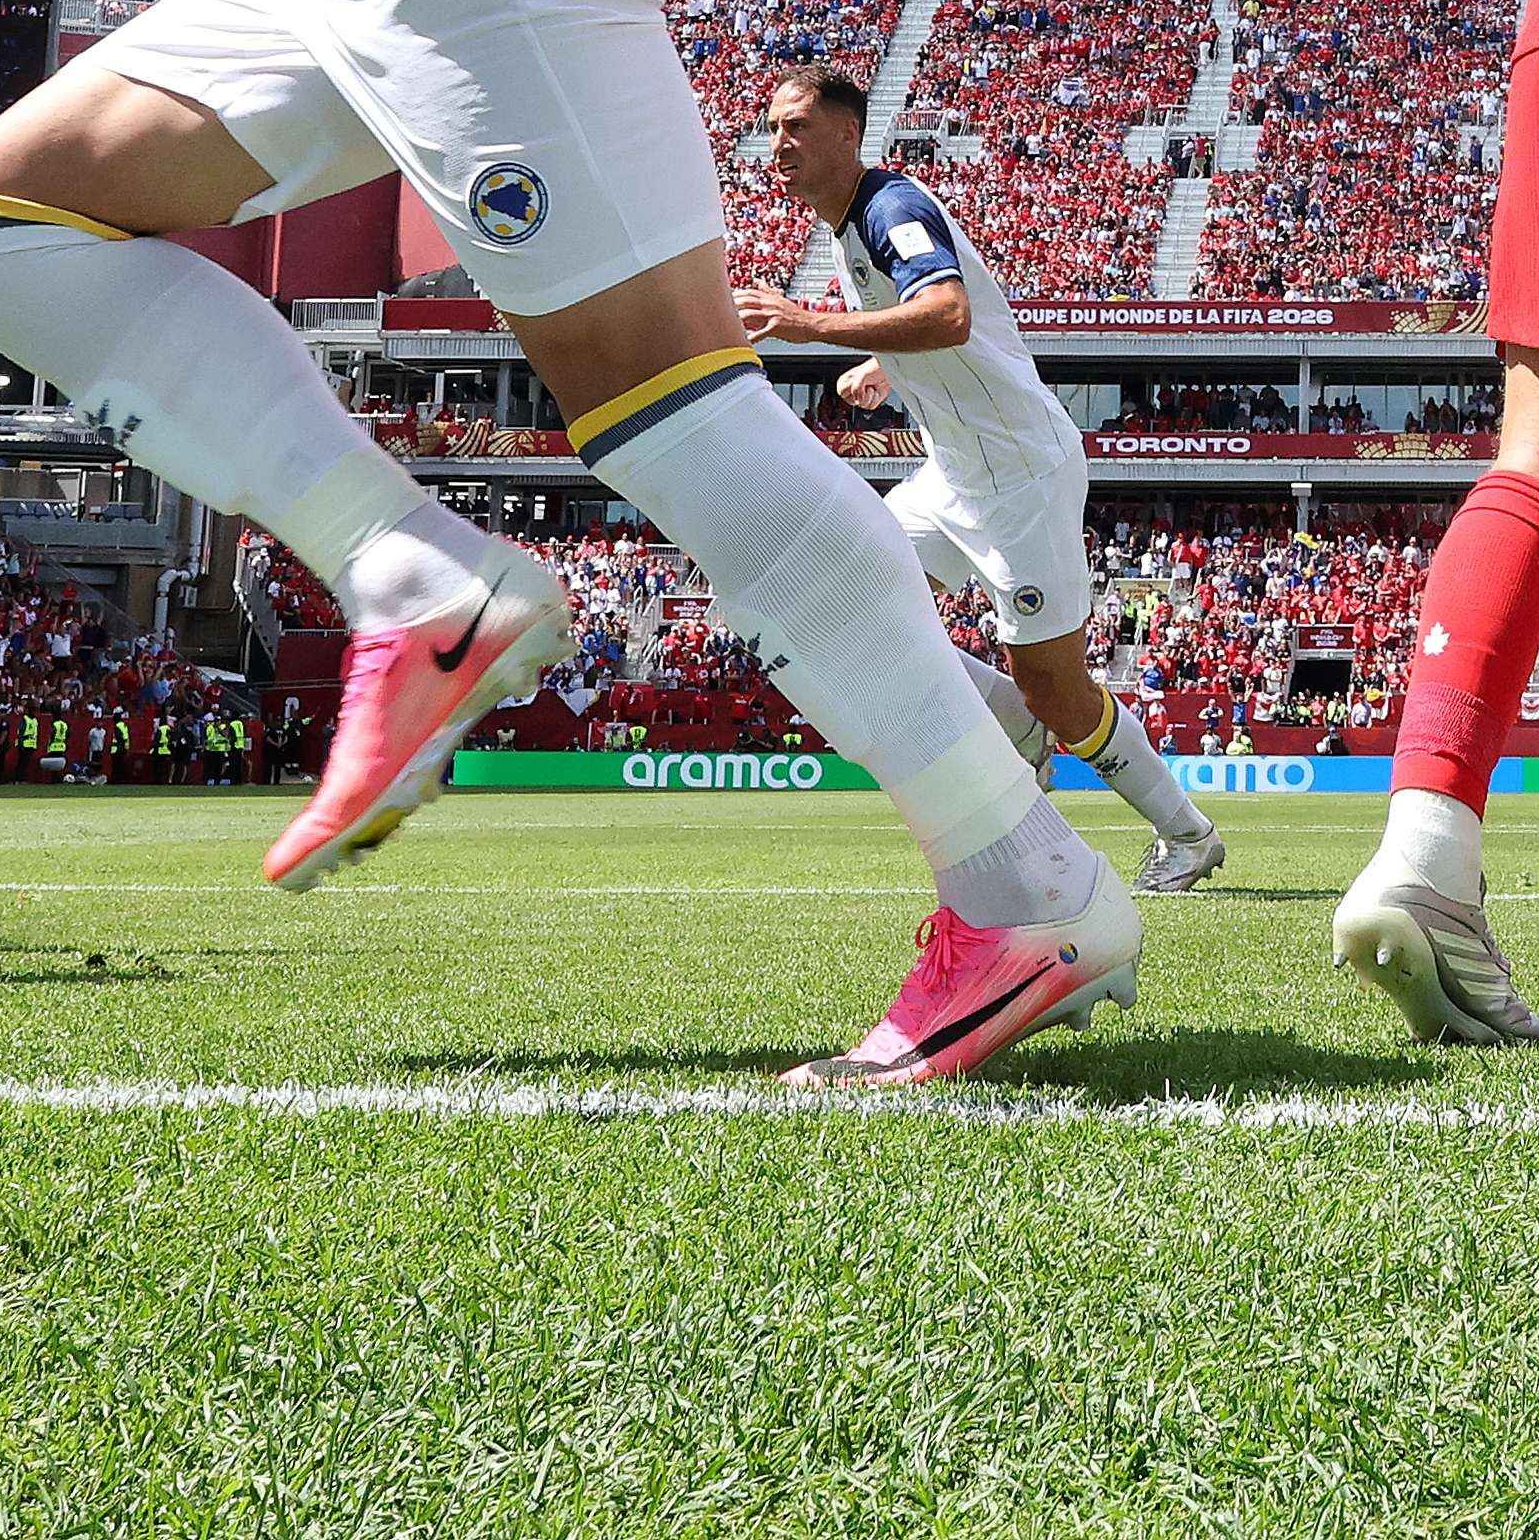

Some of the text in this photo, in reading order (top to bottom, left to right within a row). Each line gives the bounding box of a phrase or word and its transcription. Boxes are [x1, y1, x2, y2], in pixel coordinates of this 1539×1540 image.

[1070, 308, 1097, 324] DU
[1099, 308, 1166, 324] MONDE
[1169, 308, 1193, 324] DE
[1196, 308, 1221, 324] LA
[1223, 308, 1264, 324] FIFA
[1267, 308, 1334, 325] 2026
[1095, 436, 1252, 453] TORONTO
[622, 753, 823, 789] aramco
